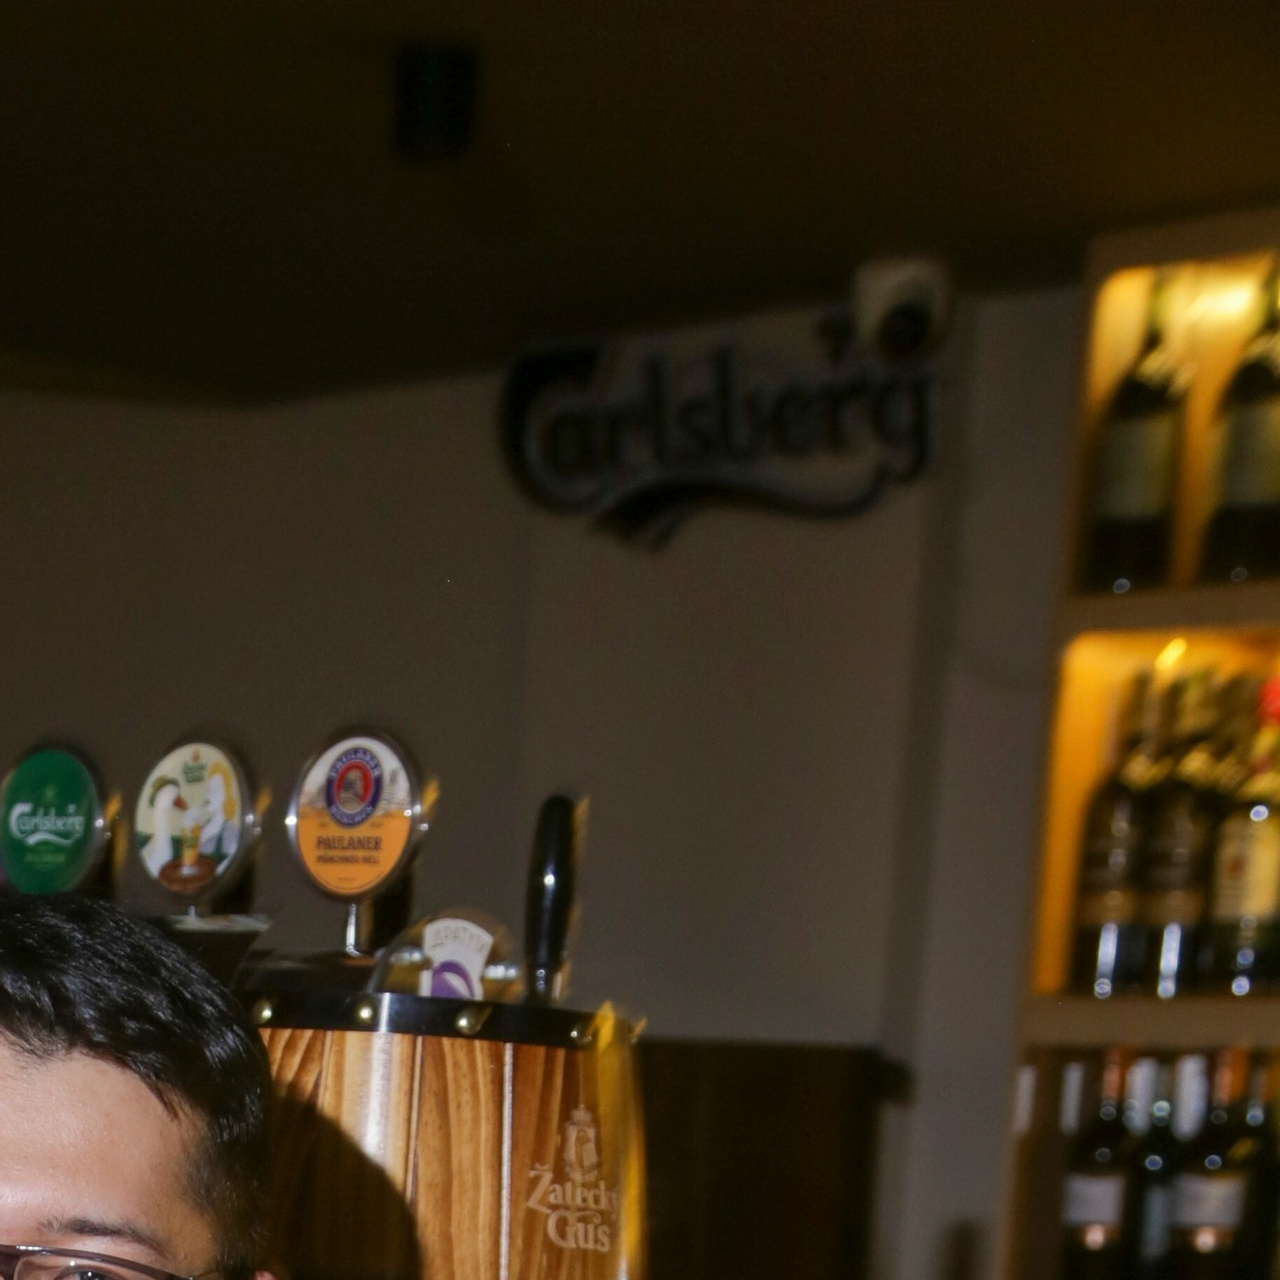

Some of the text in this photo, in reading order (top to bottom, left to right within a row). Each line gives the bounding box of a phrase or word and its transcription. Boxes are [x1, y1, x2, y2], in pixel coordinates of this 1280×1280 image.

[503, 325, 934, 546] Carlsberg
[9, 802, 85, 847] Carlsberg
[317, 835, 382, 851] PAULANER
[547, 1208, 611, 1253] Gus
